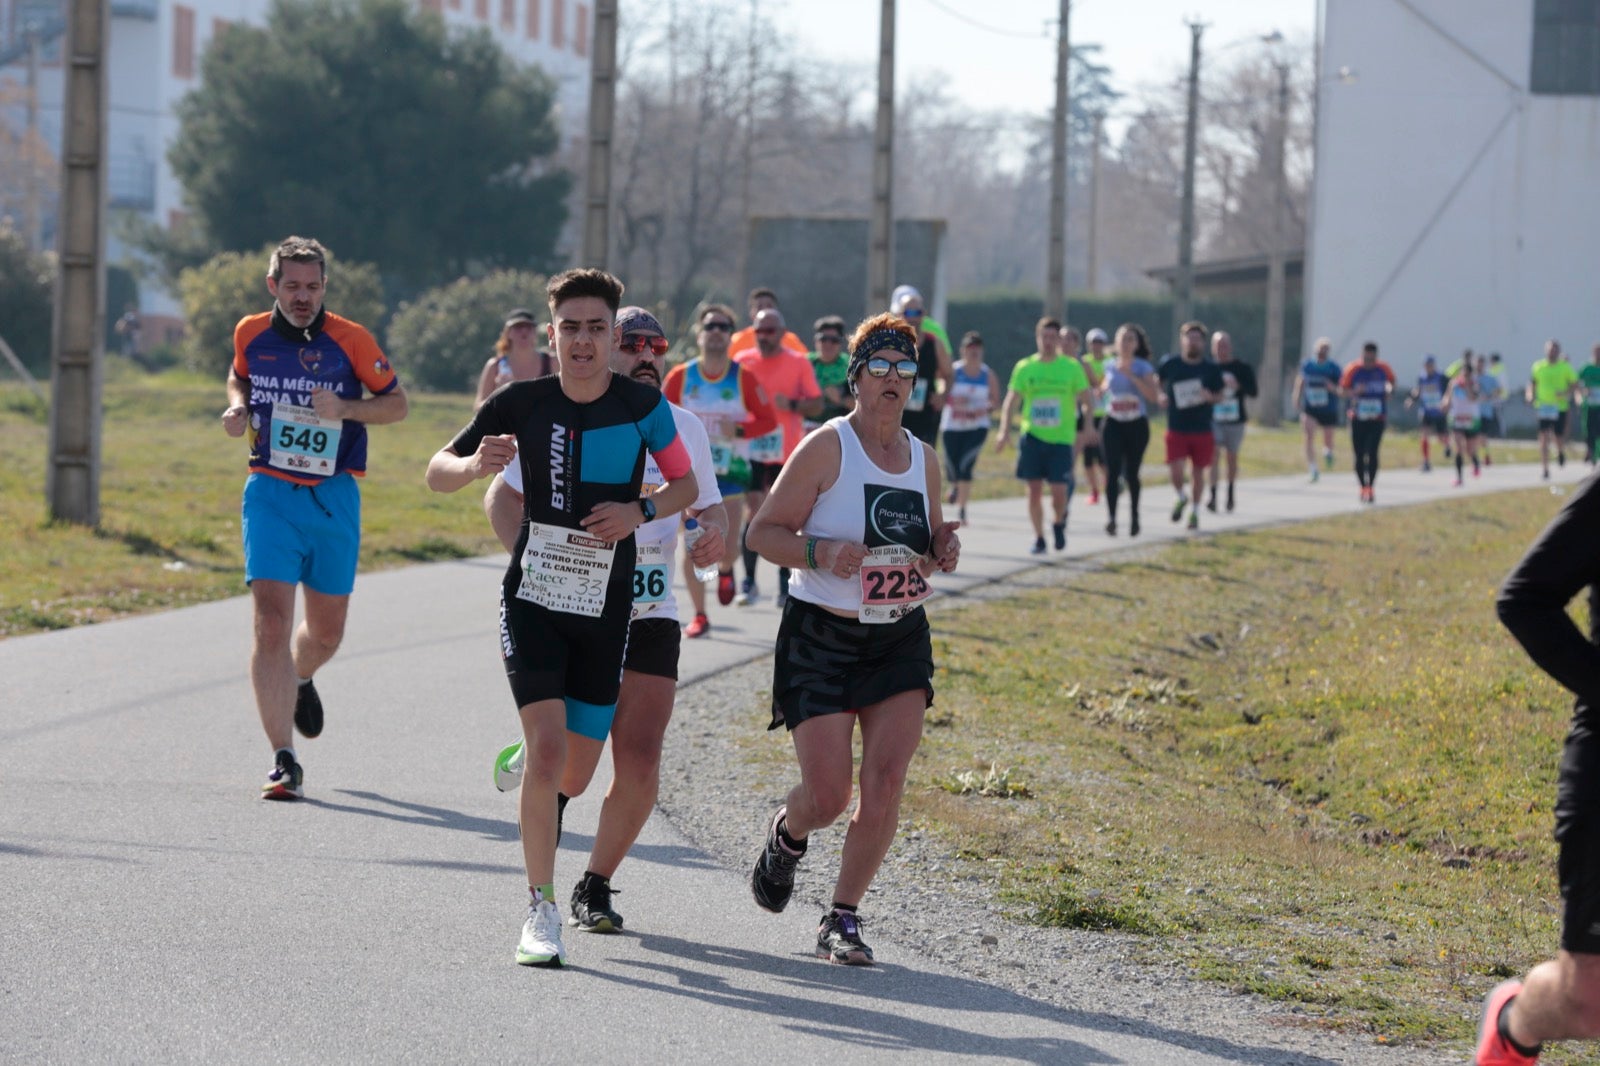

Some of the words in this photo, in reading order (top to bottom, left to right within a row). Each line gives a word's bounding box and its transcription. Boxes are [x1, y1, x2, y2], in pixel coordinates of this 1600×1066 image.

[279, 425, 328, 454] 549
[879, 508, 909, 520] Planet
[911, 514, 923, 523] life
[572, 535, 606, 549] Cruzcampo
[884, 548, 899, 556] GRAN
[528, 549, 539, 557] YO
[541, 552, 571, 563] CORRO
[573, 559, 609, 570] CONTRA
[891, 557, 908, 565] DIPUT
[542, 562, 552, 570] EL
[554, 565, 590, 576] CANCER
[536, 572, 568, 586] aecc
[575, 577, 603, 597] 33
